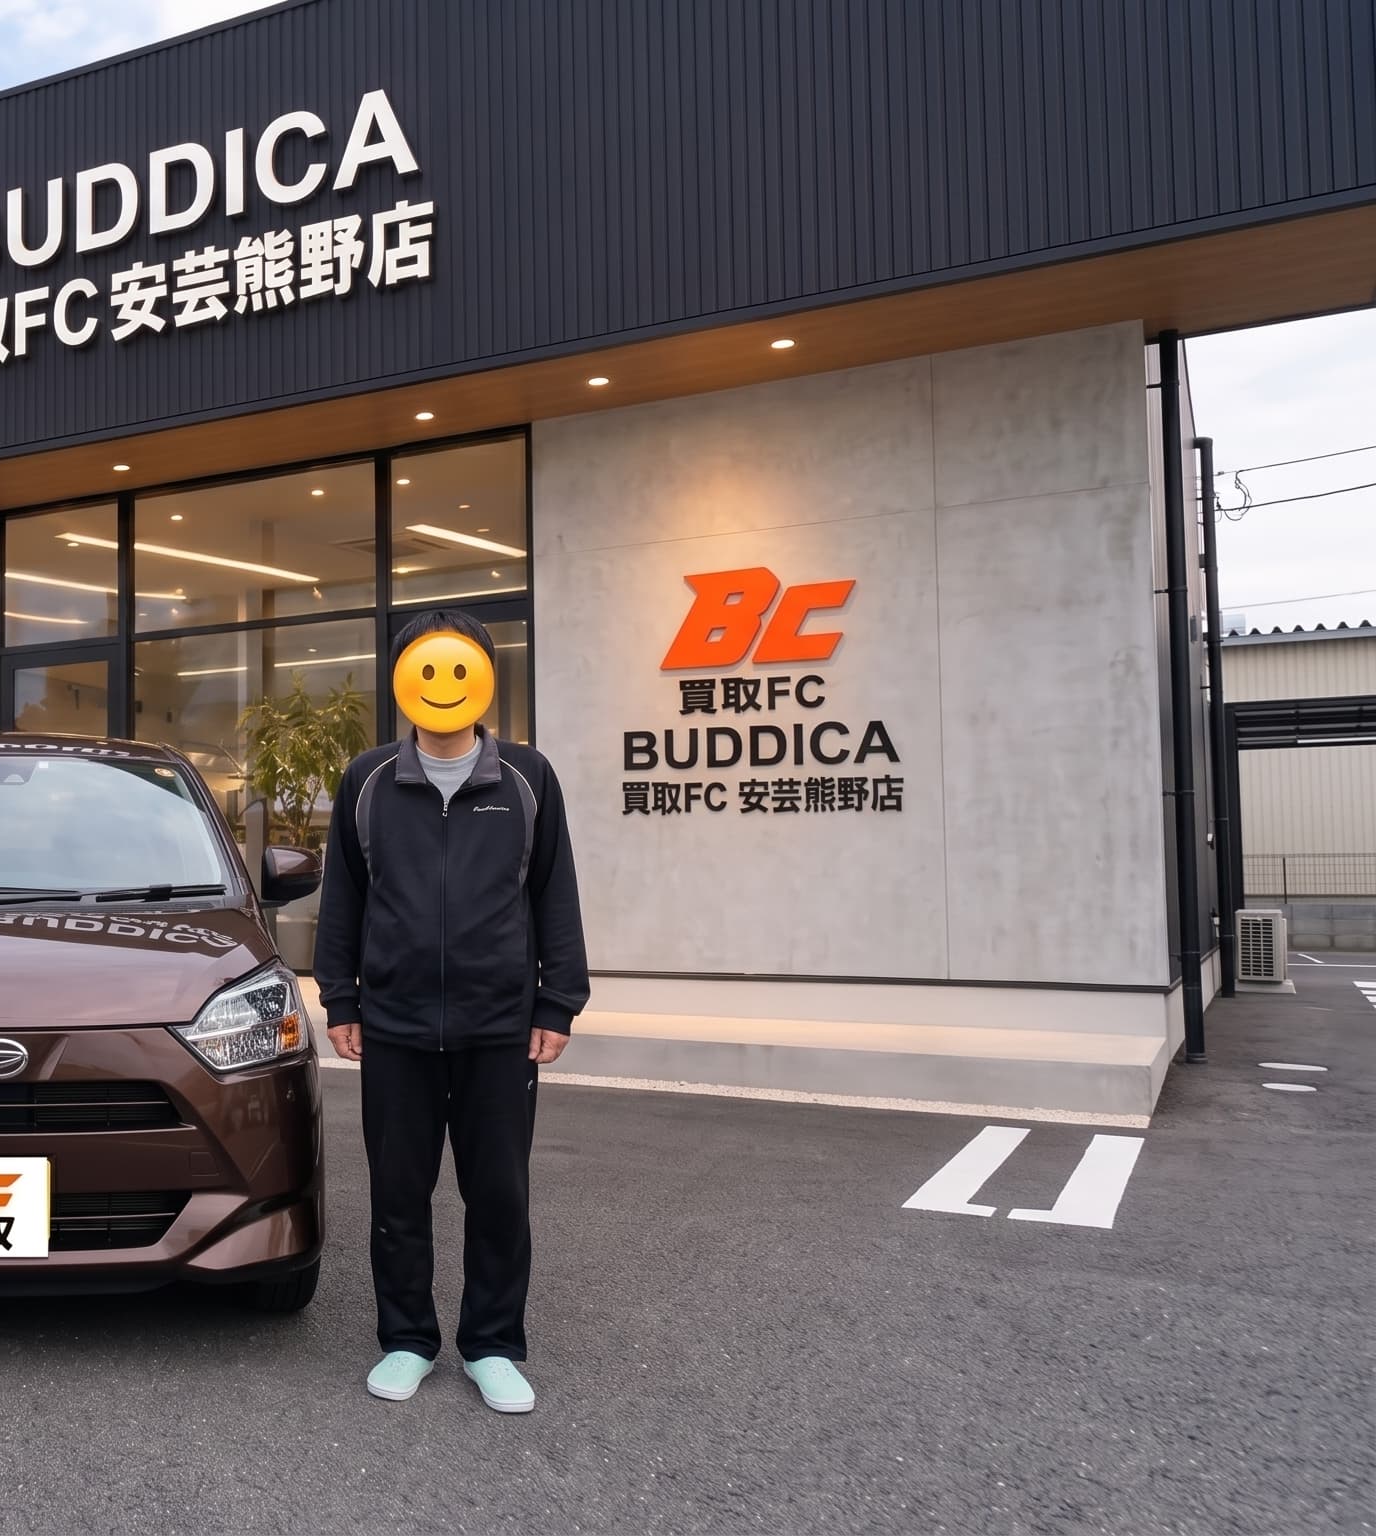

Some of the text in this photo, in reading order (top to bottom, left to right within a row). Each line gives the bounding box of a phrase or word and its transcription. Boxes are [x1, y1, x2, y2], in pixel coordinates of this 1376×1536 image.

[659, 565, 857, 671] BC
[678, 674, 827, 716] 買取FC
[623, 719, 902, 771] BUDDICA
[622, 774, 905, 816] 買取FC 安芸熊野店
